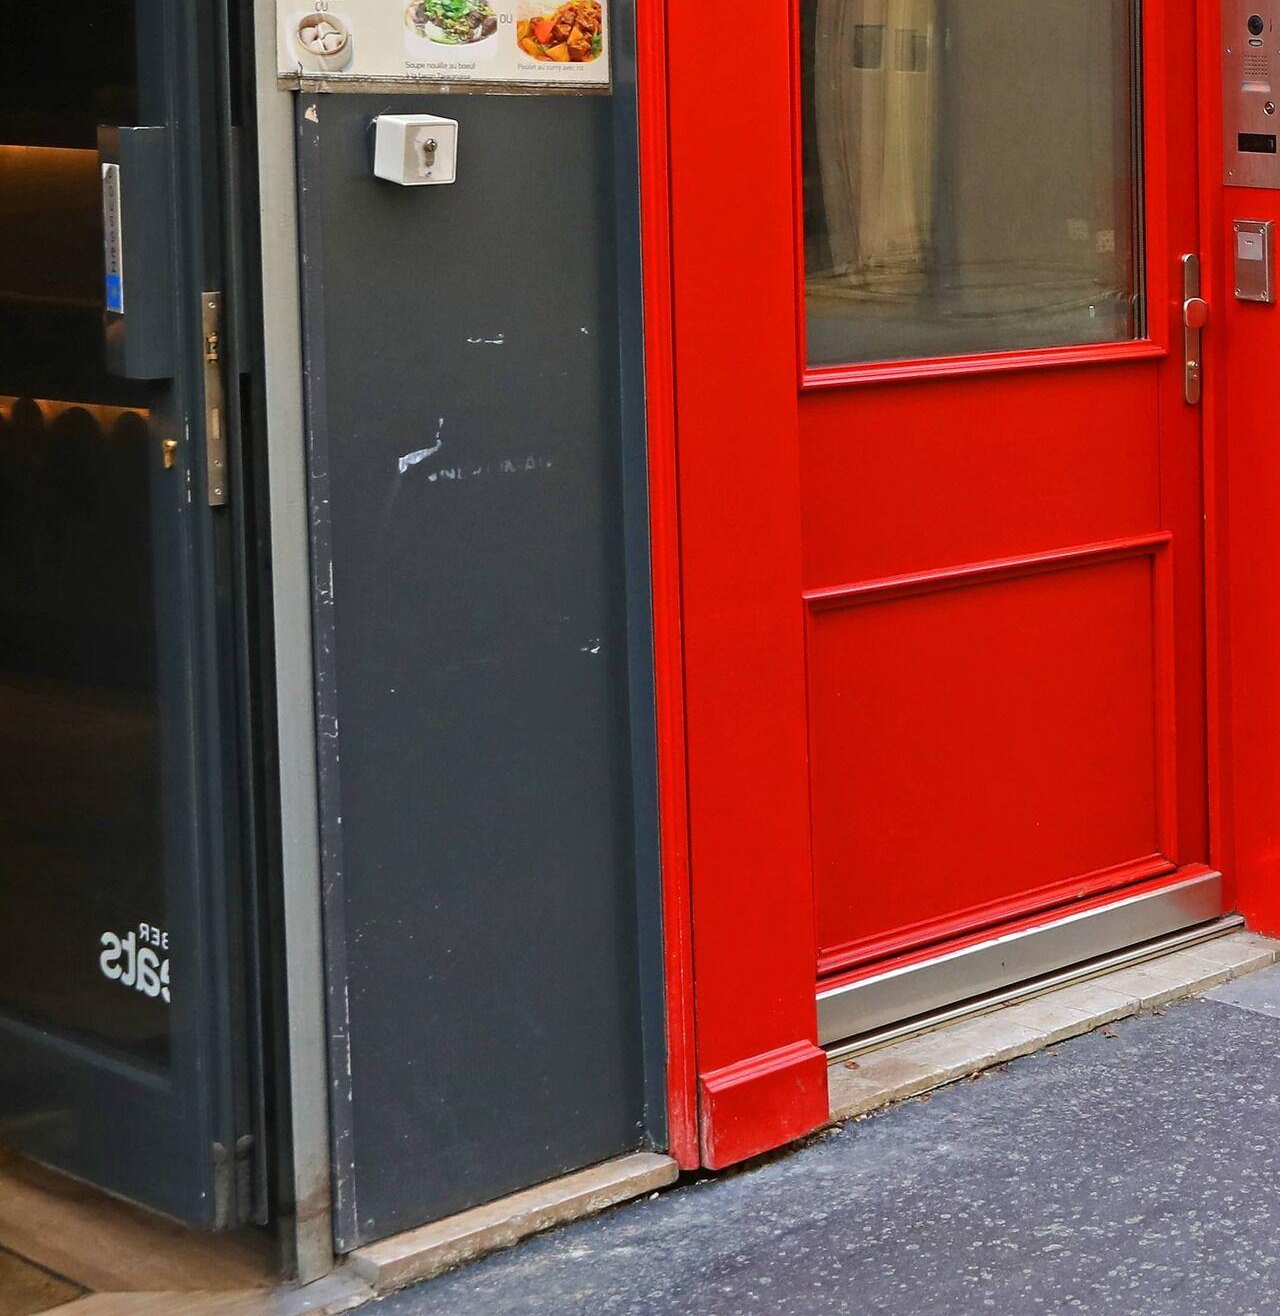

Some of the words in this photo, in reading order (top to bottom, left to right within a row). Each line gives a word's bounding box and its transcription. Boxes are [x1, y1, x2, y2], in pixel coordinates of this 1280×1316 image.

[315, 1, 329, 12] OU
[500, 13, 513, 24] OU
[405, 61, 425, 71] Soupe
